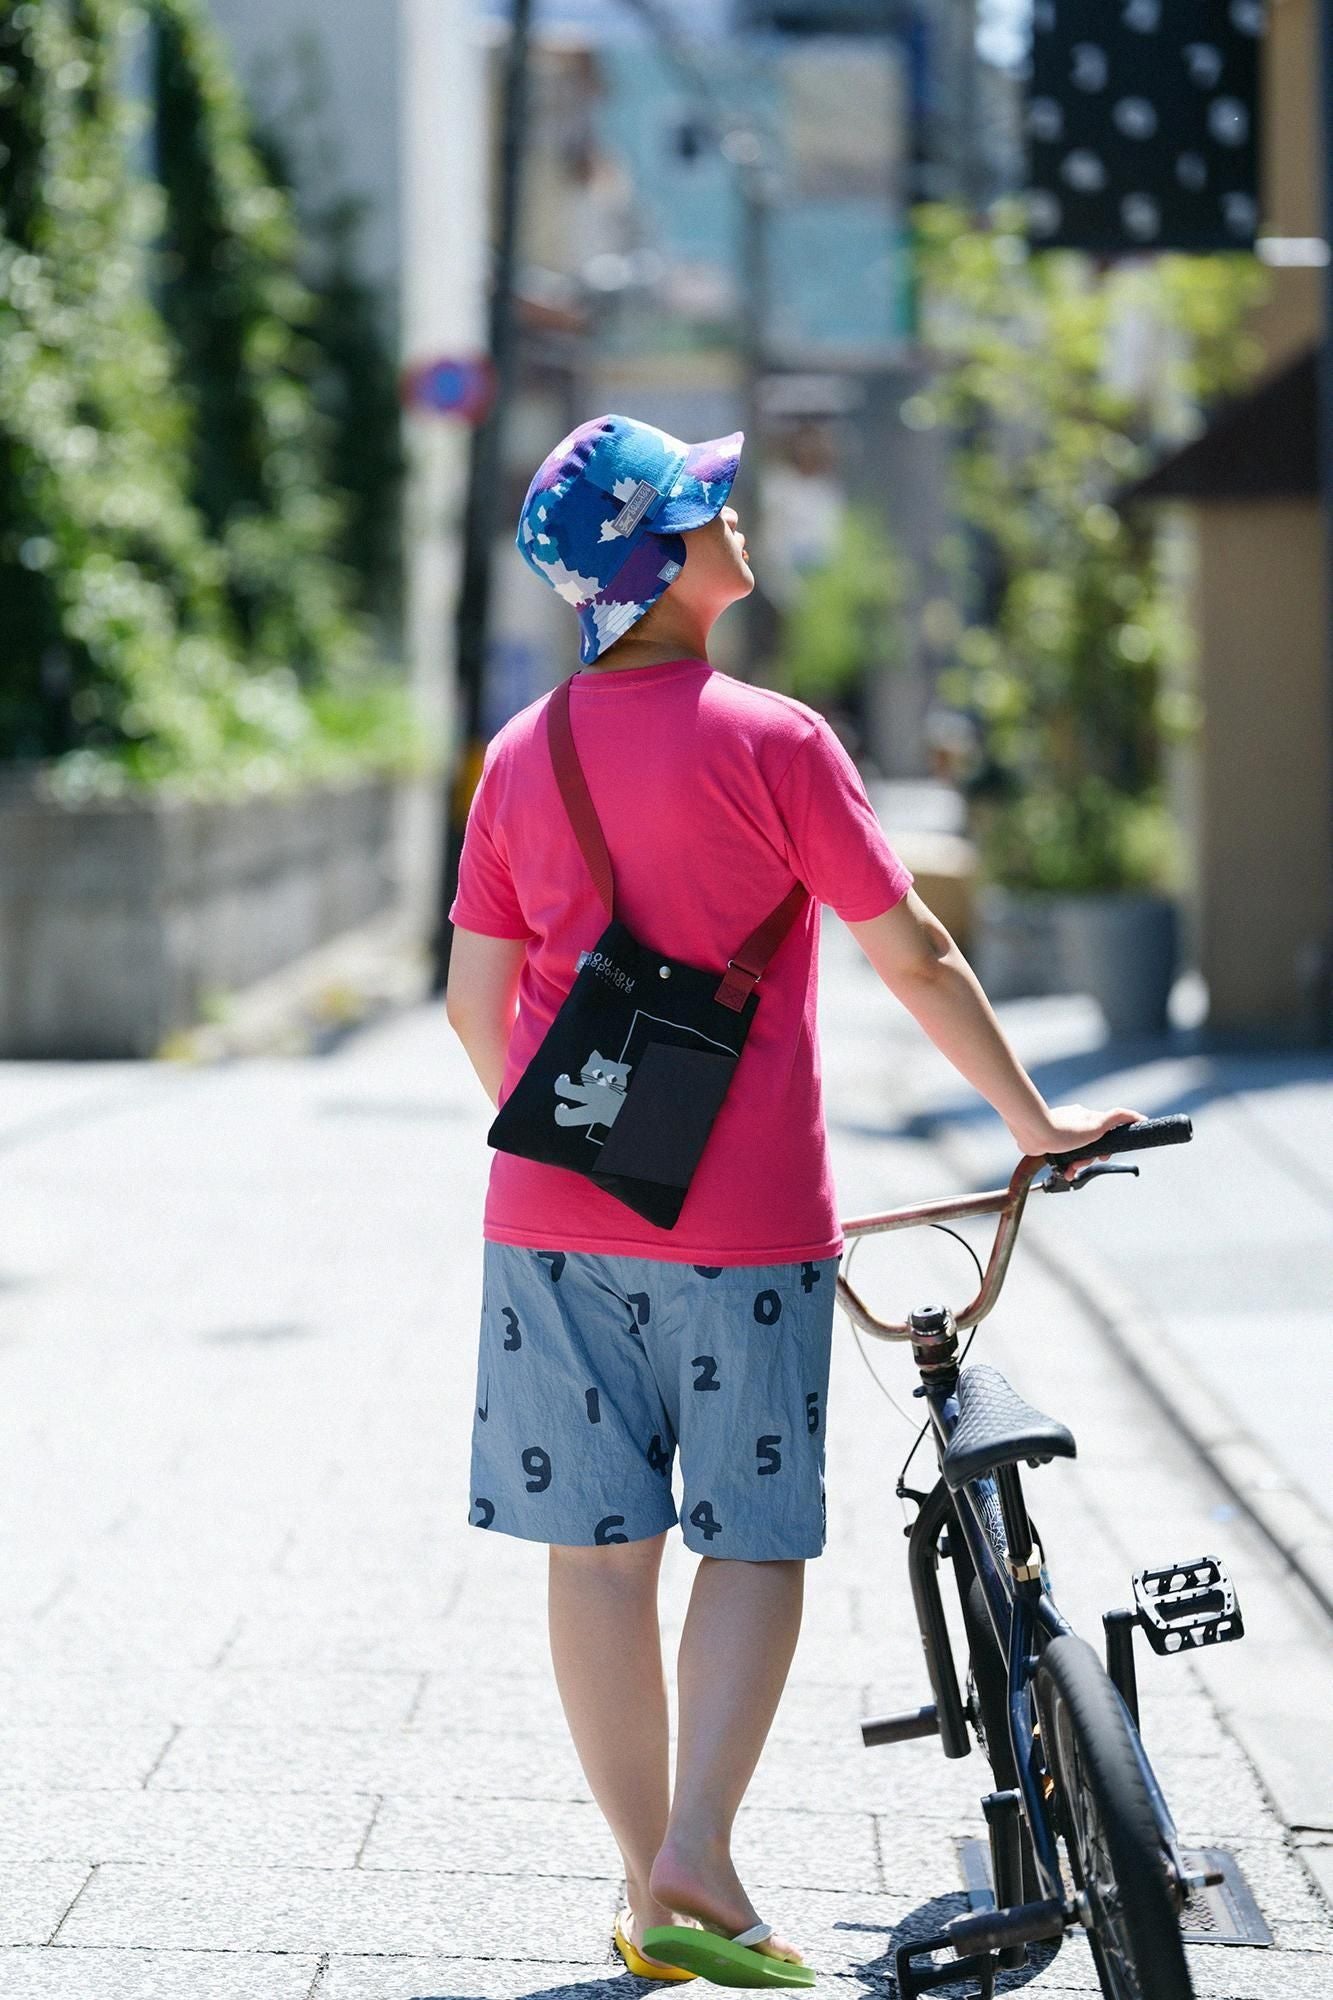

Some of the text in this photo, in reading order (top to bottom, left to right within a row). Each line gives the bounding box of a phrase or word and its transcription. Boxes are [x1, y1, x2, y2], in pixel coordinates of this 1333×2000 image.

[753, 1289, 782, 1326] 0
[501, 1306, 522, 1352] 3
[691, 1355, 721, 1391] 2
[585, 1387, 601, 1424] 1
[521, 1446, 552, 1493] 9
[647, 1434, 670, 1477] 4
[756, 1434, 783, 1475] 5
[690, 1500, 723, 1541] 4
